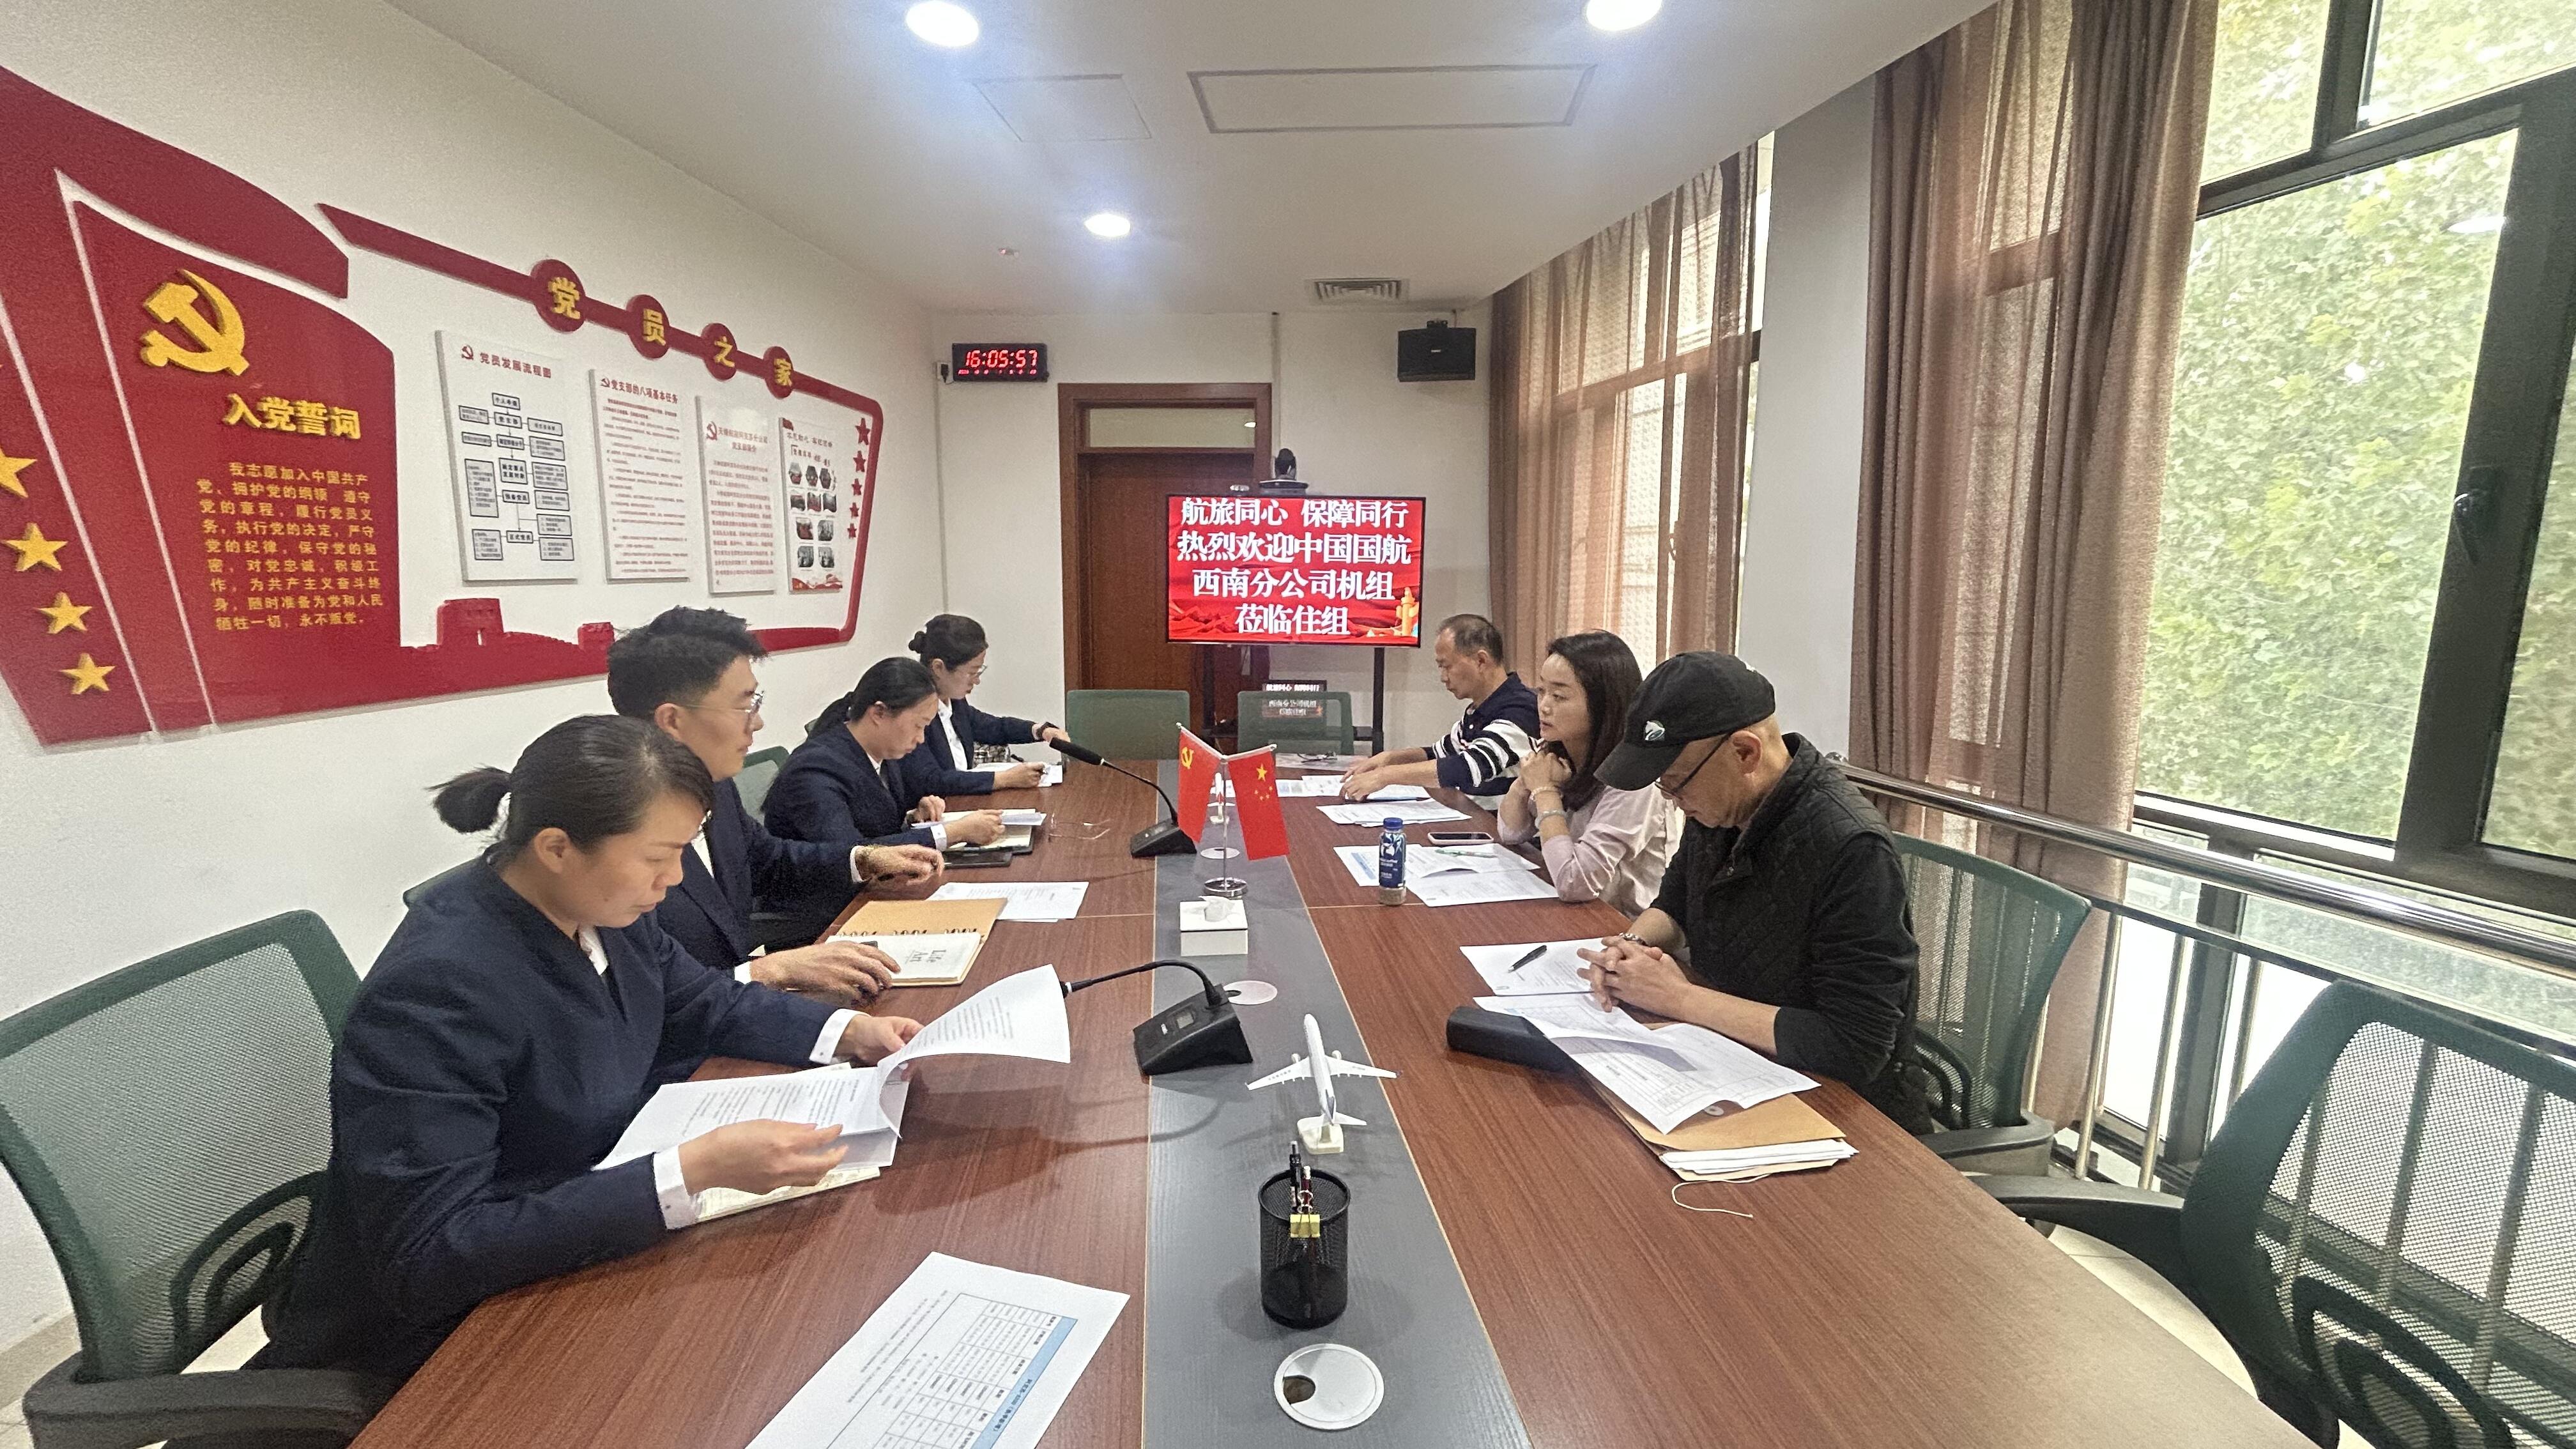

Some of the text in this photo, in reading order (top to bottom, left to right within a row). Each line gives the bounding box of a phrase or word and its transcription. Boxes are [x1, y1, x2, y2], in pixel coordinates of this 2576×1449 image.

[548, 276, 793, 387] 党员之家
[480, 352, 551, 379] 党员发展流程图
[965, 349, 1038, 368] 16:05:57
[611, 379, 678, 404] 党支部的八项基本任务
[223, 392, 362, 440] 入党誓词
[229, 462, 369, 486] 我志愿加入中国共产
[1181, 497, 1409, 528] 航旅同心 保障同行
[1177, 530, 1413, 565] 热烈欢迎中国国航
[1192, 567, 1396, 601] 西南分公司机组
[1234, 602, 1351, 636] 莅临住组
